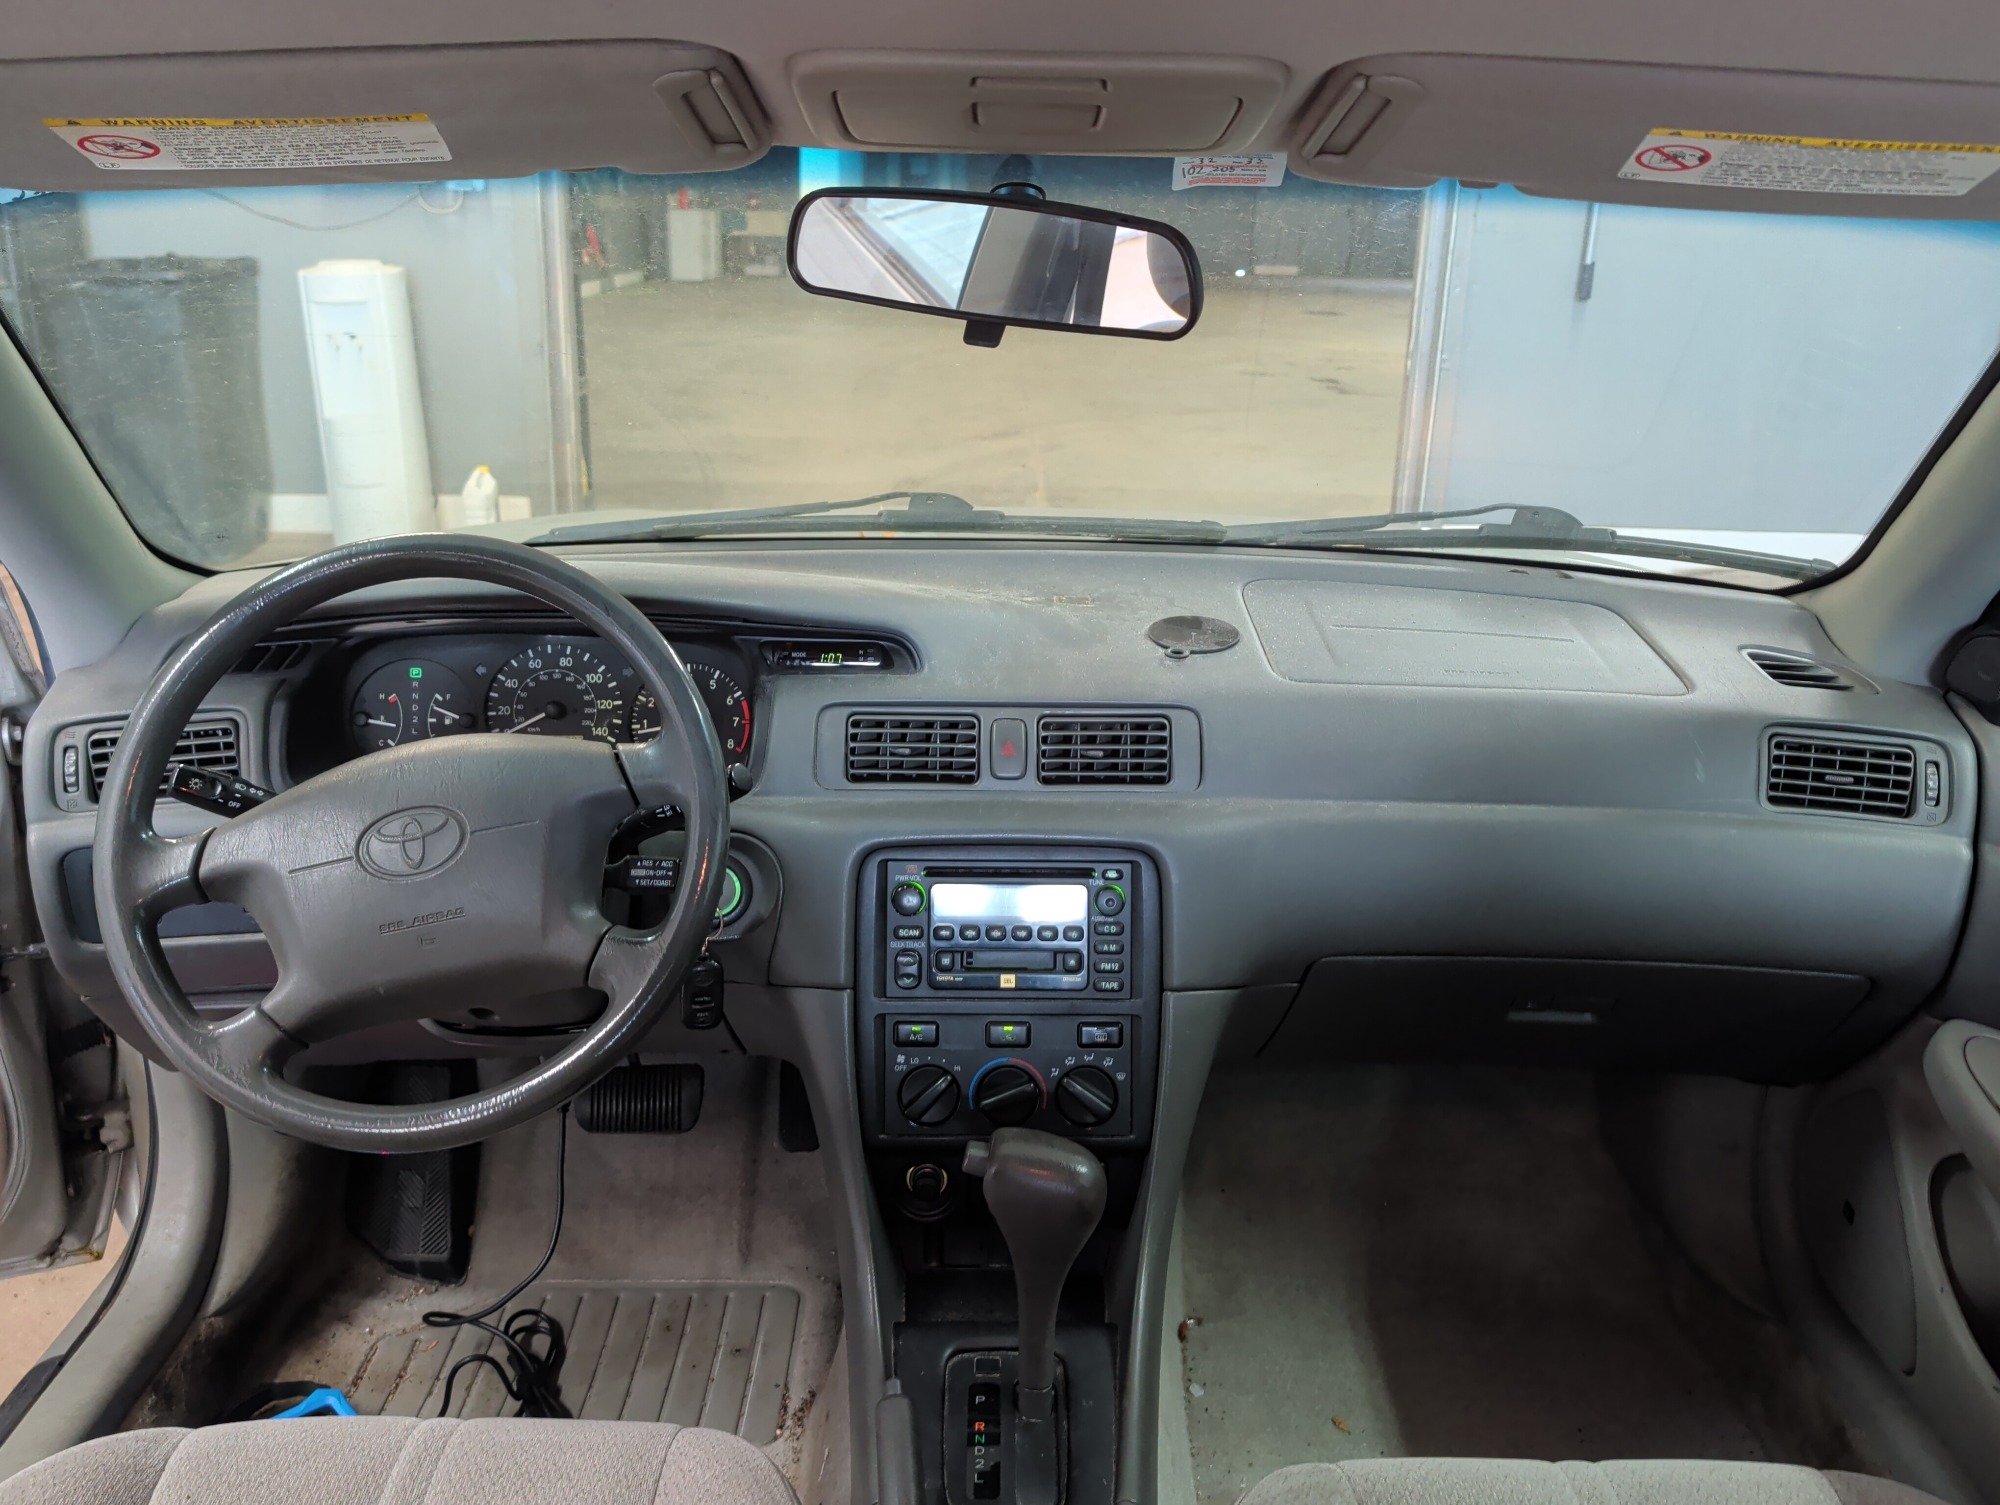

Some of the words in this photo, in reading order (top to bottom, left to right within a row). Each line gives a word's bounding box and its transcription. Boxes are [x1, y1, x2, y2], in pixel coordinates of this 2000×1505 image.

[100, 119, 207, 127] WARNING
[559, 657, 573, 667] 80
[820, 653, 842, 663] 1:07
[528, 659, 542, 669] 60
[585, 673, 603, 683] 100
[504, 679, 518, 688] 40
[709, 680, 717, 690] 5
[597, 699, 613, 709] 120
[648, 697, 655, 707] 2
[726, 695, 733, 705] 6
[498, 705, 511, 716] 20
[643, 719, 648, 729] 1
[732, 717, 739, 727] 7
[592, 726, 609, 737] 140
[378, 739, 384, 747] C
[727, 738, 734, 749] 8
[228, 801, 241, 809] OFF
[412, 906, 465, 926] AIRBAG
[898, 928, 920, 937] SCAN
[1101, 981, 1119, 989] TAPE
[909, 1033, 923, 1041] A/C
[894, 1064, 908, 1072] OFF
[975, 1395, 985, 1405] P
[975, 1421, 985, 1431] R
[975, 1433, 985, 1444] N
[974, 1445, 985, 1456] D
[975, 1458, 985, 1469] 2
[974, 1473, 984, 1483] L
